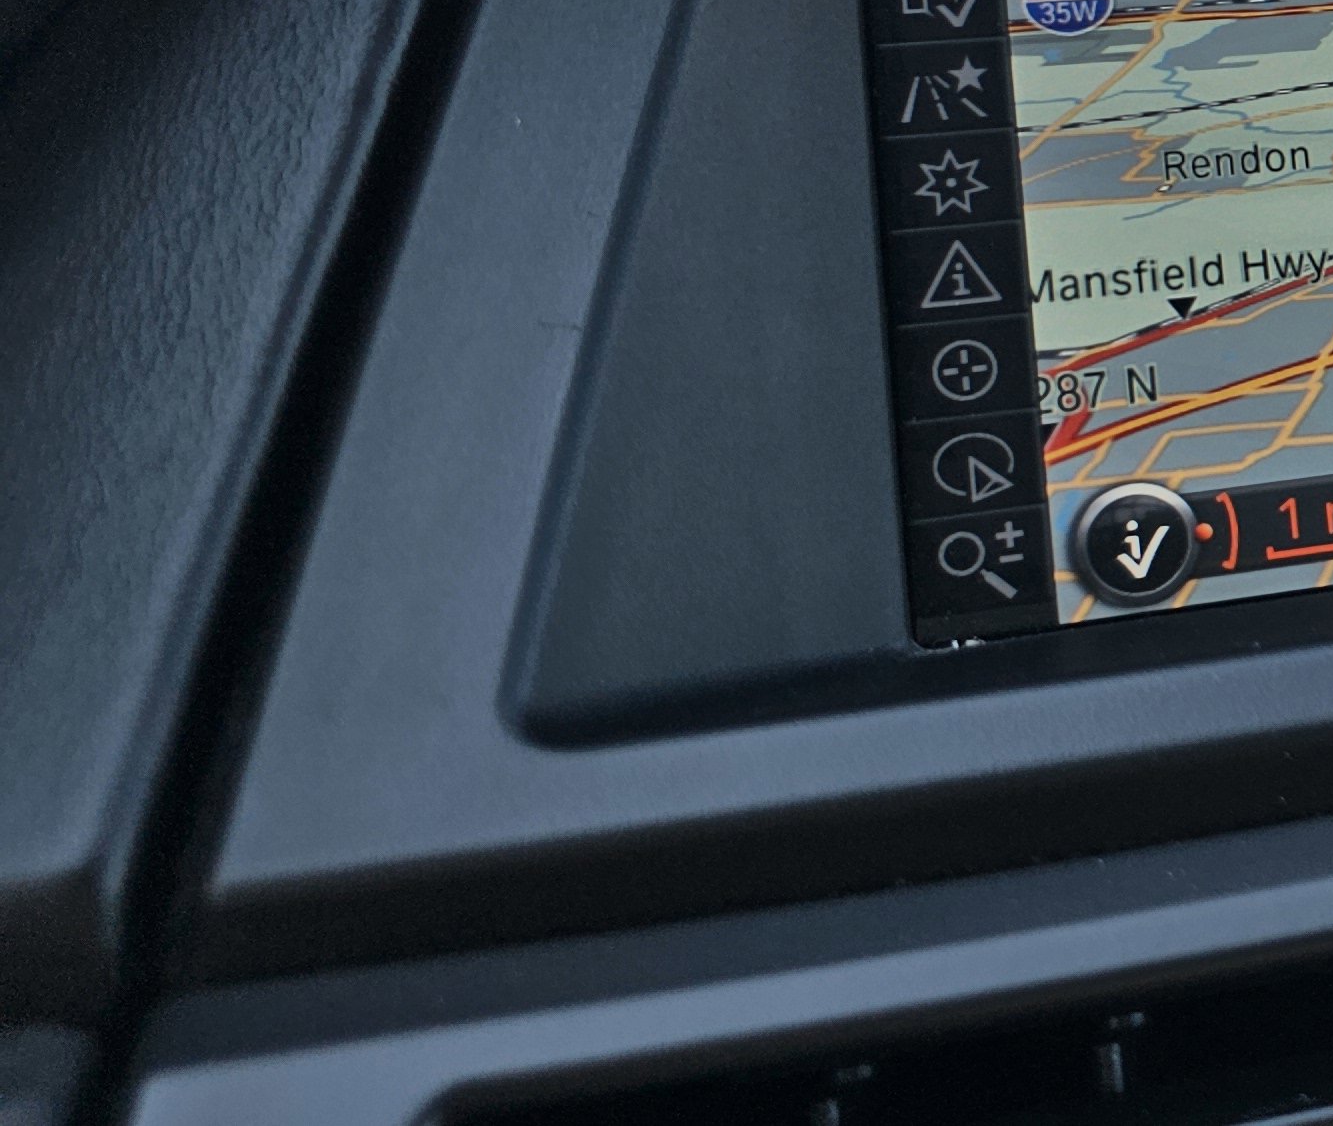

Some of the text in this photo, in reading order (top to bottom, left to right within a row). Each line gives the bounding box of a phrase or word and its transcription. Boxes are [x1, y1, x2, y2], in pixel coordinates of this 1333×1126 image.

[1162, 142, 1312, 183] Rendon
[1030, 247, 1328, 304] Mansfield Hwy
[1125, 365, 1158, 405] N
[1279, 497, 1300, 542] 1
